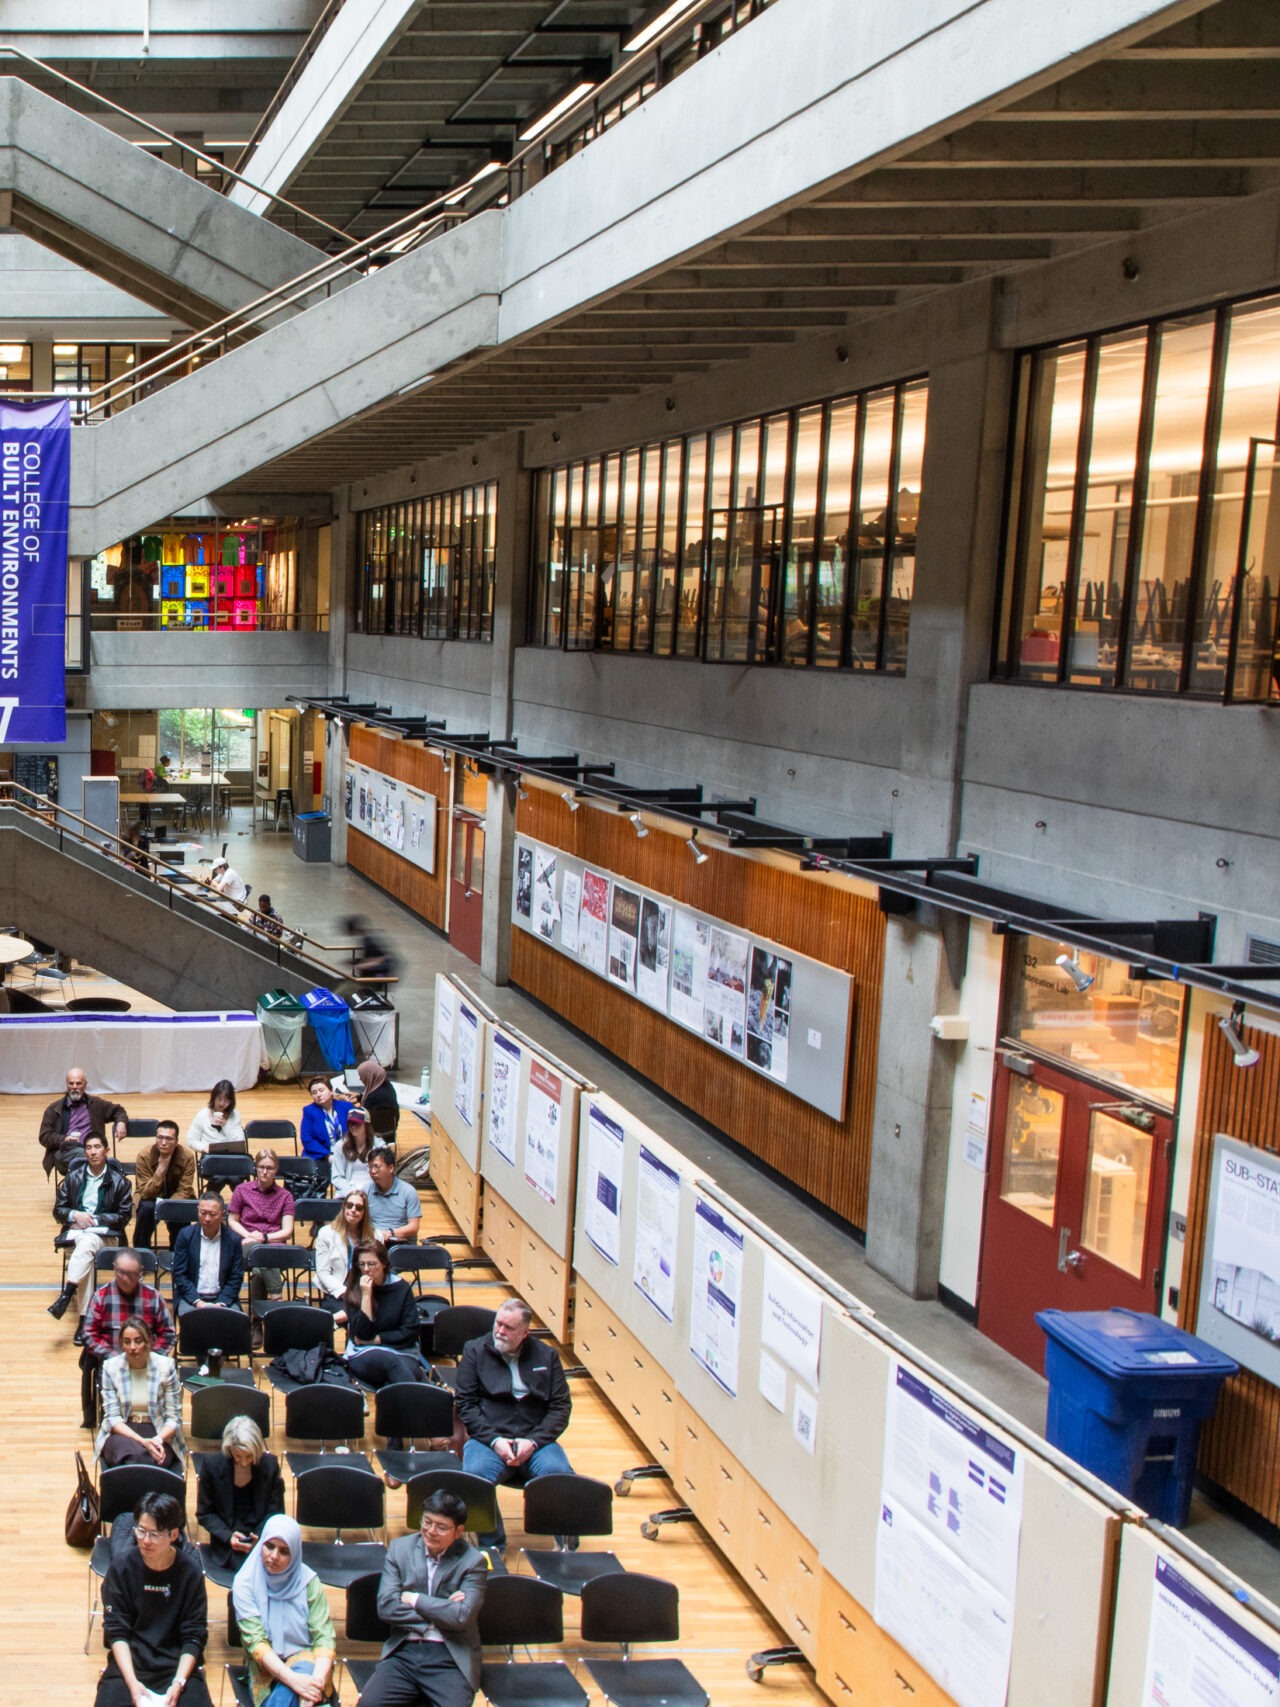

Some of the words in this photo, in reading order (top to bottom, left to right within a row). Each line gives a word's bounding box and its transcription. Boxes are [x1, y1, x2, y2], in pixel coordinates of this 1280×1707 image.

[3, 442, 20, 504] BUILT
[24, 442, 40, 529] COLLEGE
[23, 535, 39, 563] OF
[2, 510, 19, 680] ENVIRONMENTS
[1056, 979, 1070, 996] Lab
